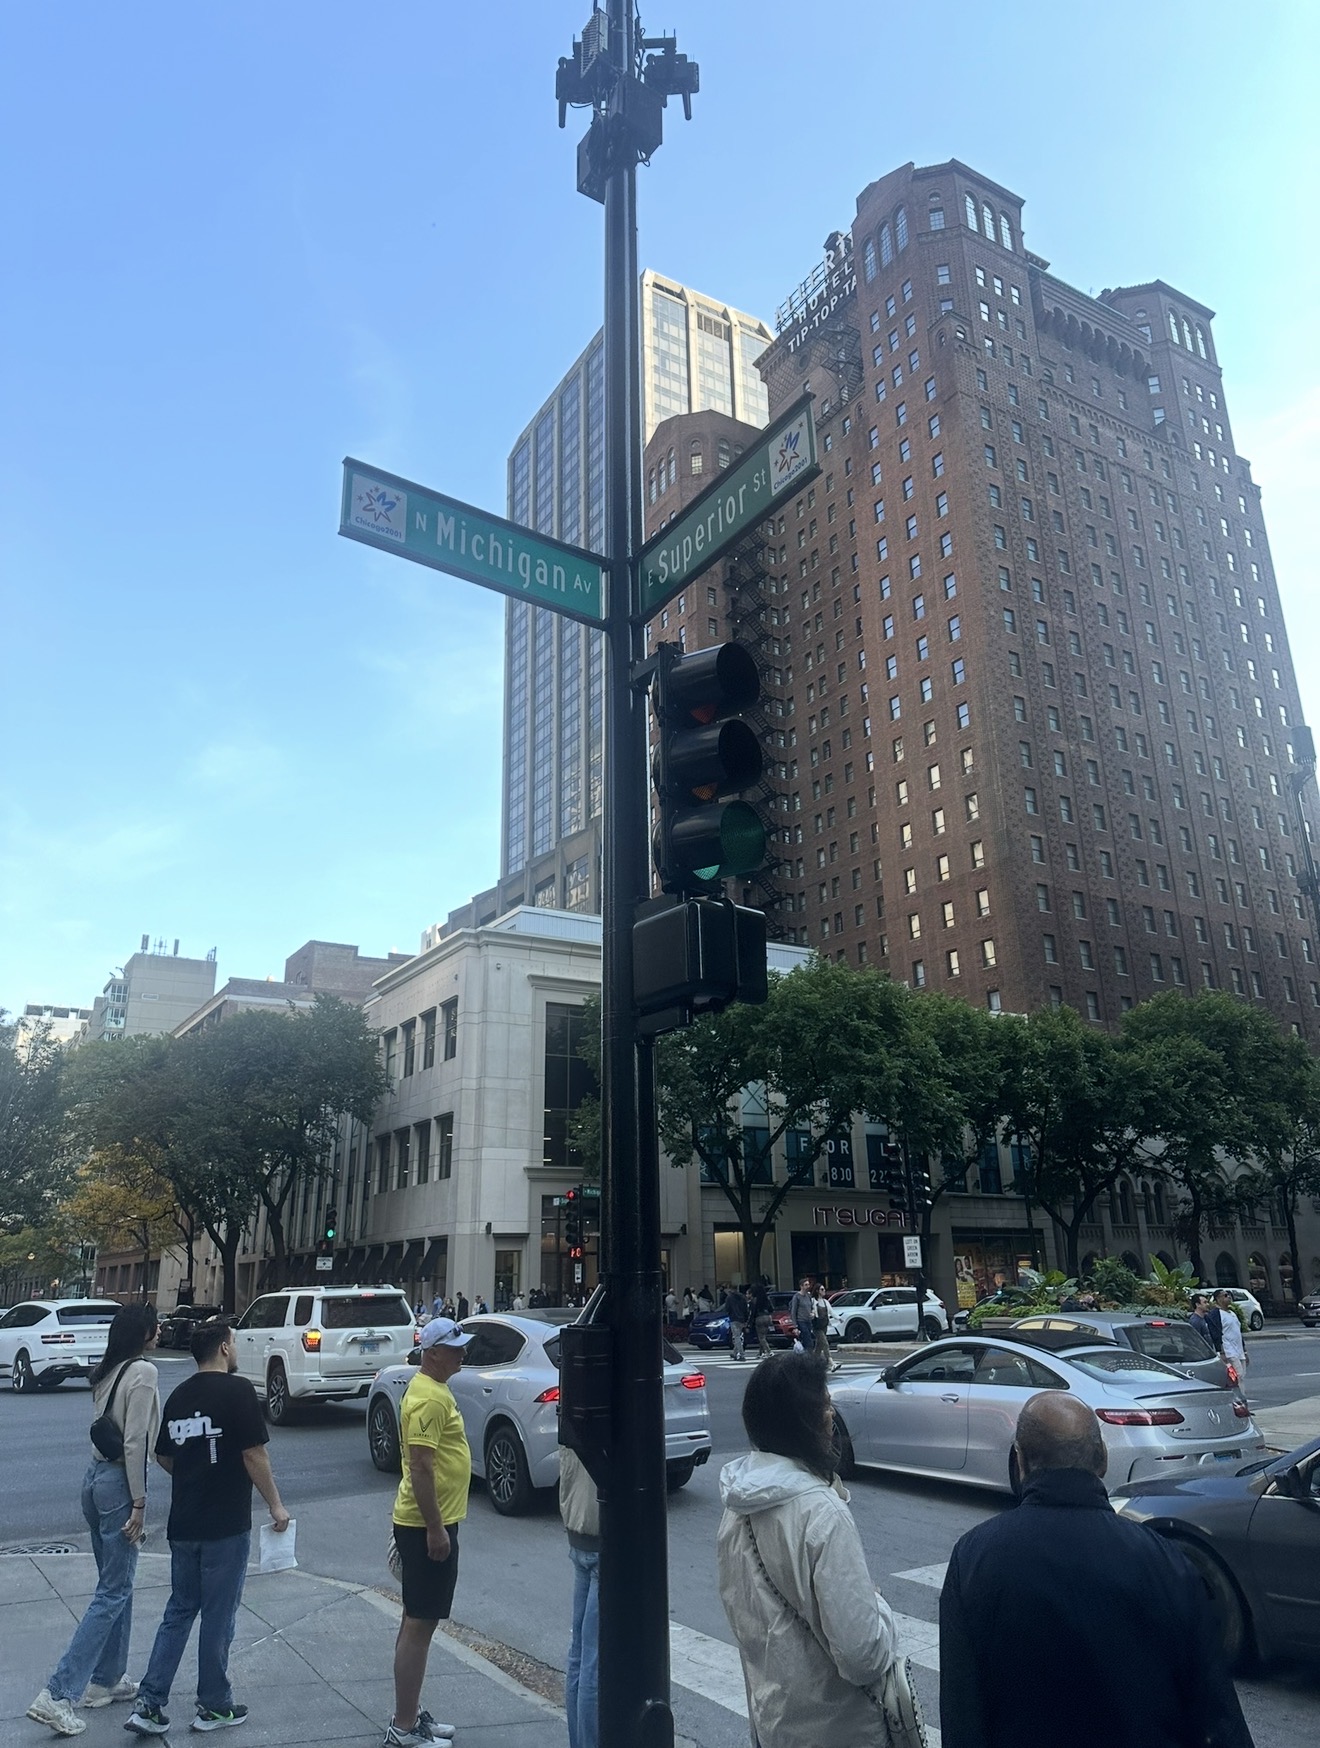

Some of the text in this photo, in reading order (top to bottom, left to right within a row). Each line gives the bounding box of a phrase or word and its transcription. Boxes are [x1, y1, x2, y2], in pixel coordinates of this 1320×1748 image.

[798, 262, 852, 324] HOTEL
[774, 457, 807, 490] Chicago2001
[355, 516, 402, 538] Chicago2001
[416, 512, 592, 594] N Michigan Av
[648, 468, 766, 587] E Superior St
